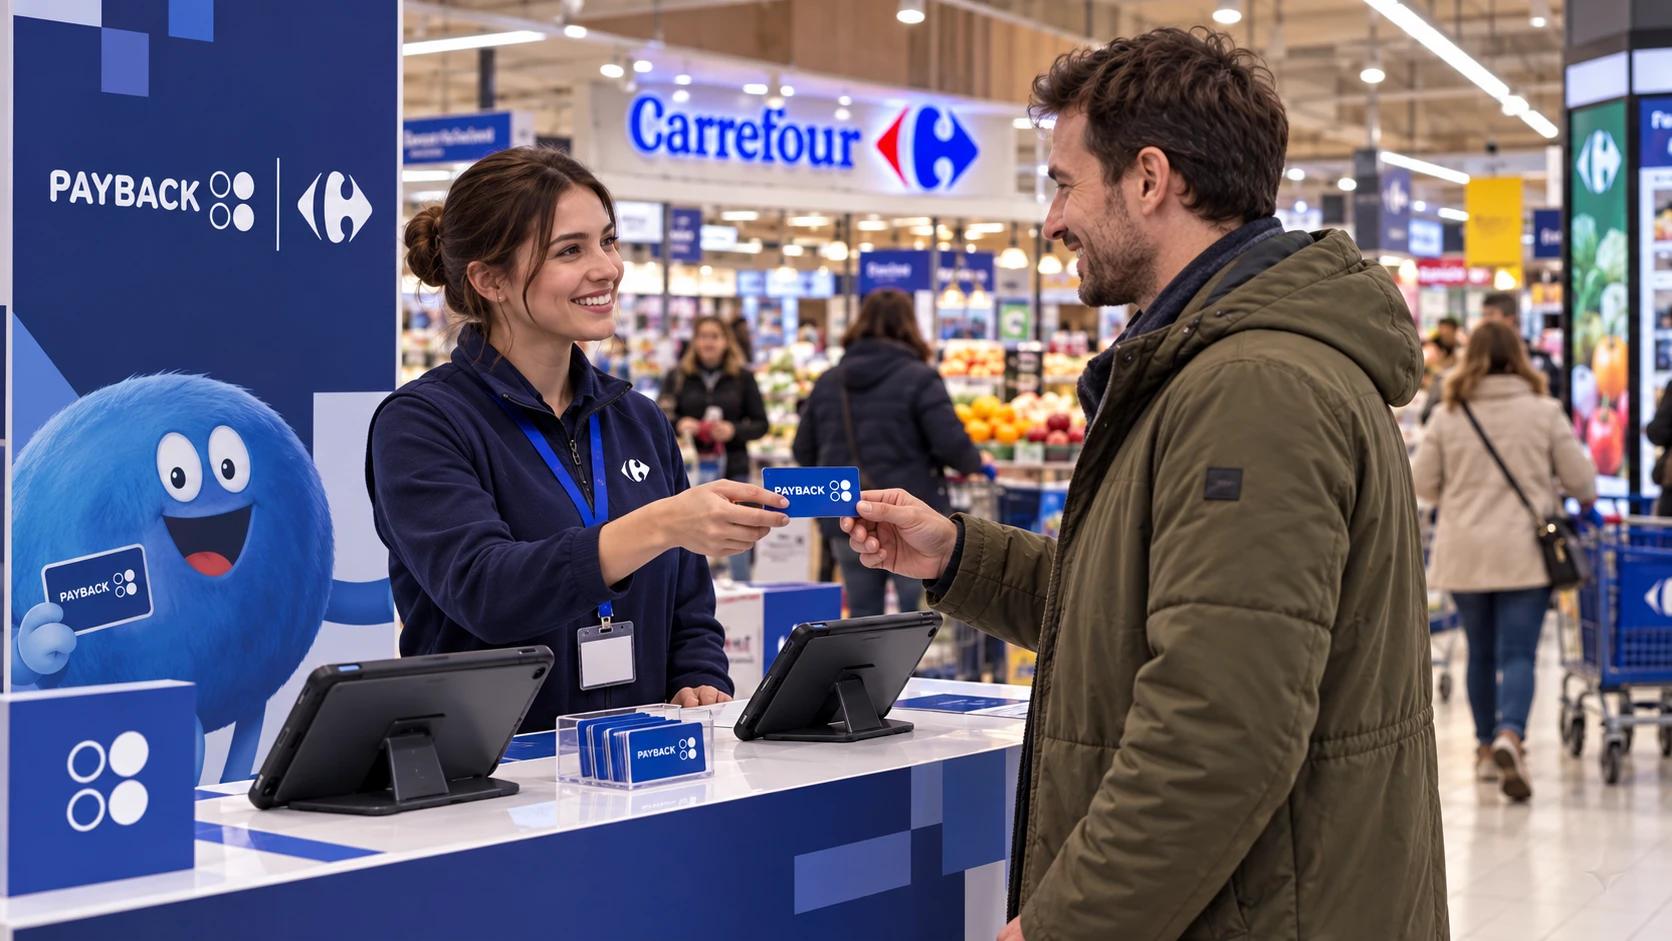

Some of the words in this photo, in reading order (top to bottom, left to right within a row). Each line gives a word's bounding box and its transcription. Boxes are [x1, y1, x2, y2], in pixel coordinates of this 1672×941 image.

[630, 94, 861, 169] Carrefour
[49, 169, 200, 212] PAYBACK
[774, 485, 826, 496] PAYBACK
[59, 581, 110, 602] PAYBACK
[637, 745, 676, 759] PAYBACK
